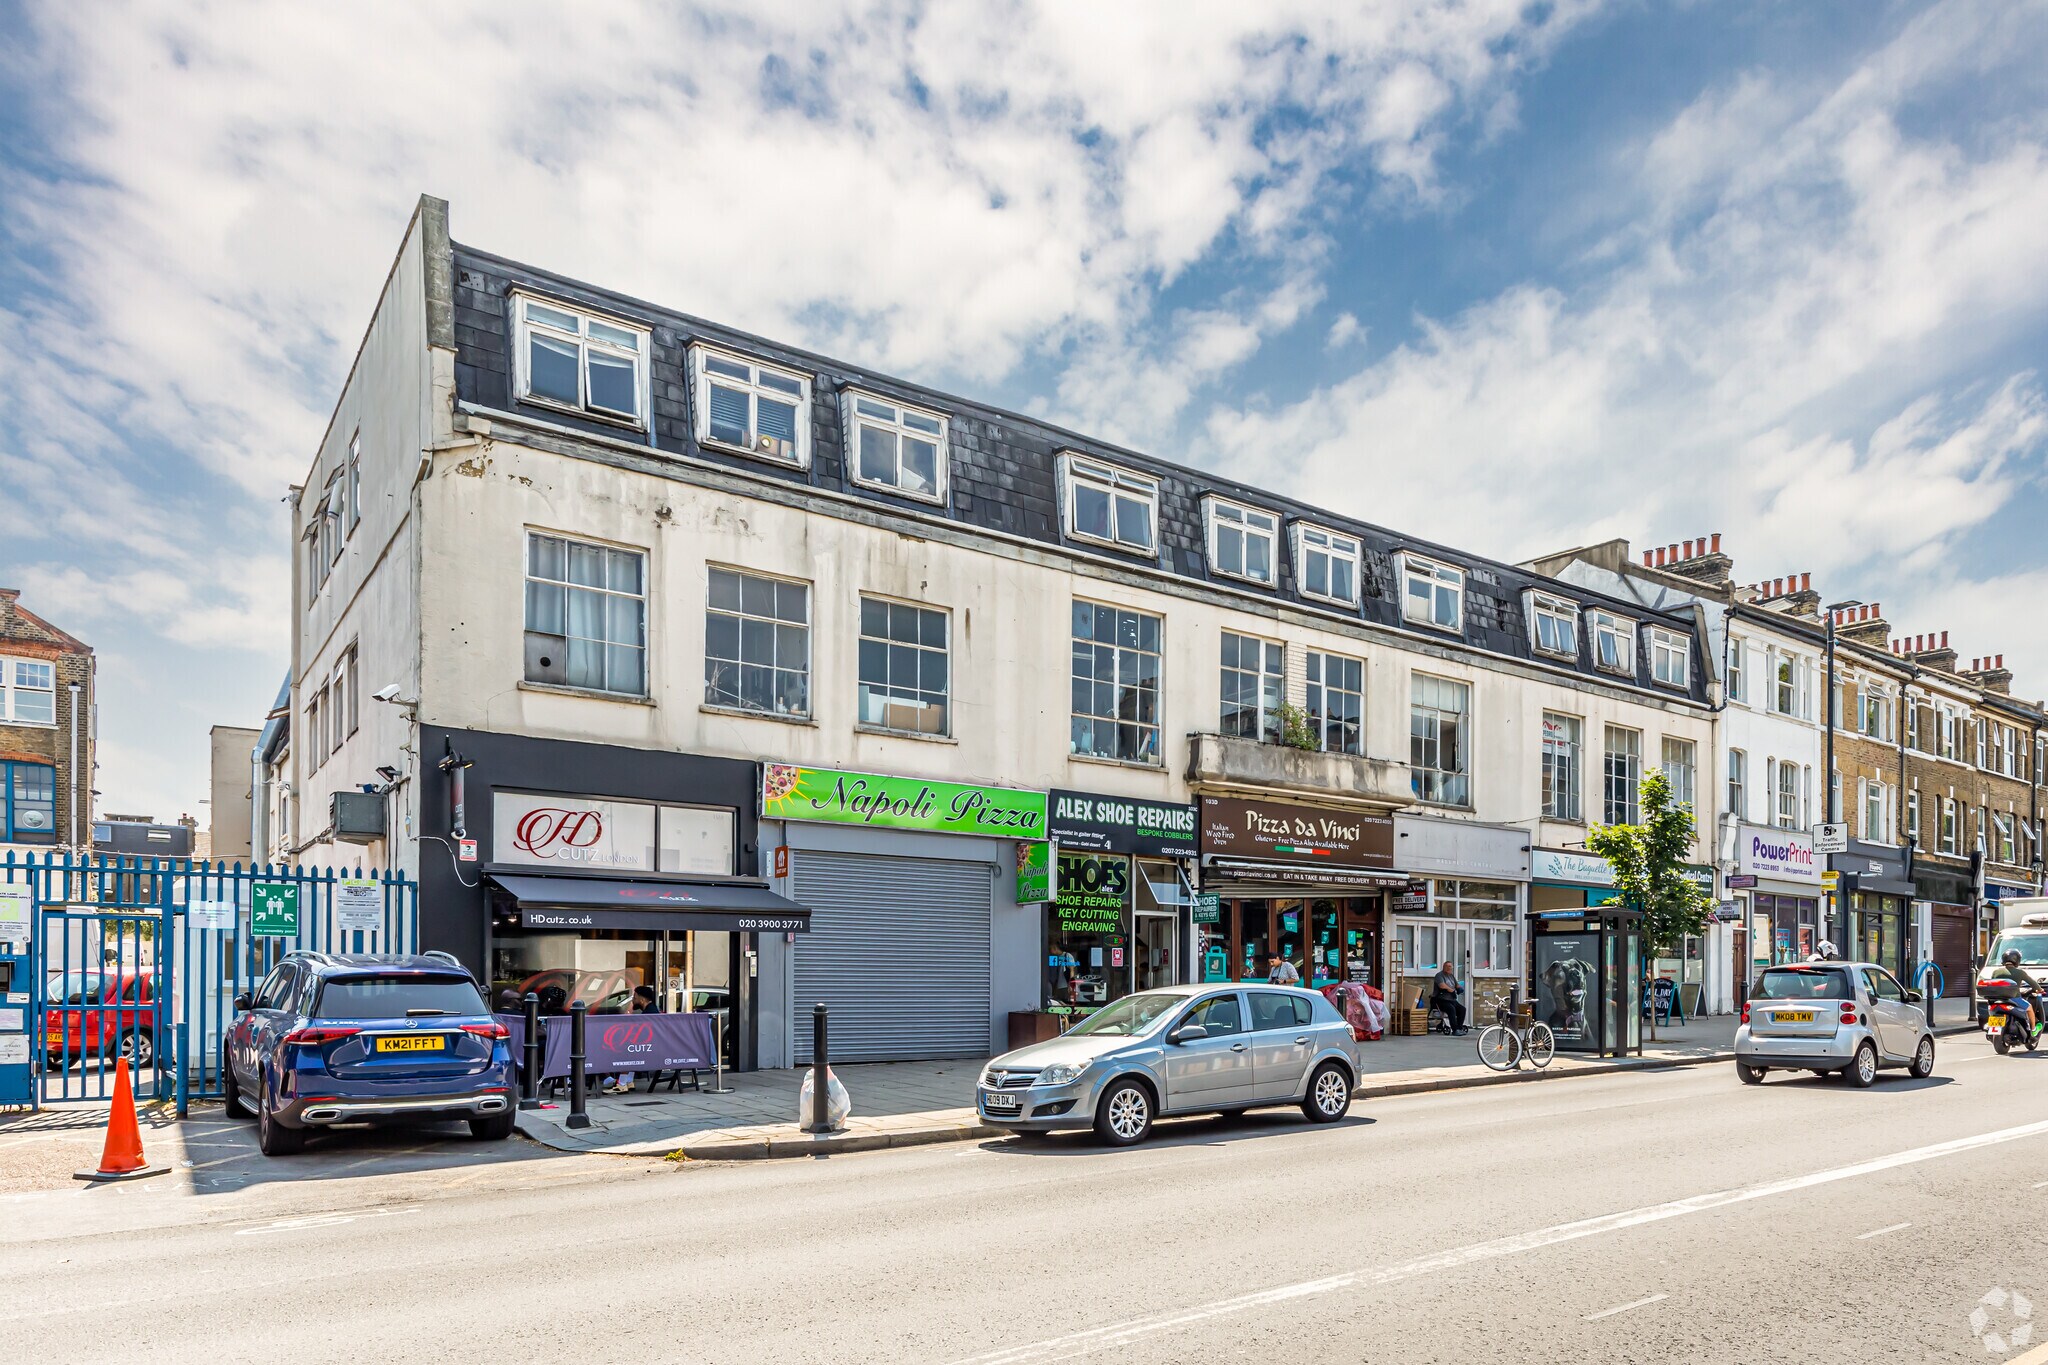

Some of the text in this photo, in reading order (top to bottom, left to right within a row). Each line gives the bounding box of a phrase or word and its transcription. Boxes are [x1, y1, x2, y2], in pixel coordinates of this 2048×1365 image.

[811, 776, 1044, 830] Napoli Pizza
[1056, 798, 1195, 831] ALEX SHOE REPAIRS
[1211, 822, 1229, 831] Italian
[1245, 810, 1360, 841] Pizza da Vinci
[1137, 828, 1193, 840] BESPOKE COBBLERS
[1205, 830, 1235, 839] Wood Fired
[1290, 838, 1303, 846] Pizza
[1303, 839, 1314, 847] Also
[1314, 840, 1338, 849] Available
[1338, 842, 1350, 850] Here
[557, 847, 640, 864] CUTZ LONDON
[1161, 847, 1197, 856] 0207-223-4931
[1753, 836, 1813, 865] PowerPrint
[1017, 861, 1049, 880] Napoli
[1563, 856, 1576, 870] The
[1578, 860, 1607, 875] Baguette
[1681, 870, 1713, 883] dical Centre
[1020, 882, 1047, 898] Pizza
[1101, 885, 1114, 893] alex
[1056, 894, 1122, 908] SHOE REPAIRS
[1058, 908, 1120, 920] KEY CUTTING
[739, 919, 804, 929] 020 3900 3771
[1061, 920, 1116, 932] ENGRAVING
[1646, 988, 1673, 997] AL DAY
[1796, 1012, 1812, 1021] TMV
[384, 1038, 437, 1050] KM21 FFT
[627, 1044, 653, 1053] CUTZ
[1001, 1096, 1014, 1106] DXJ
